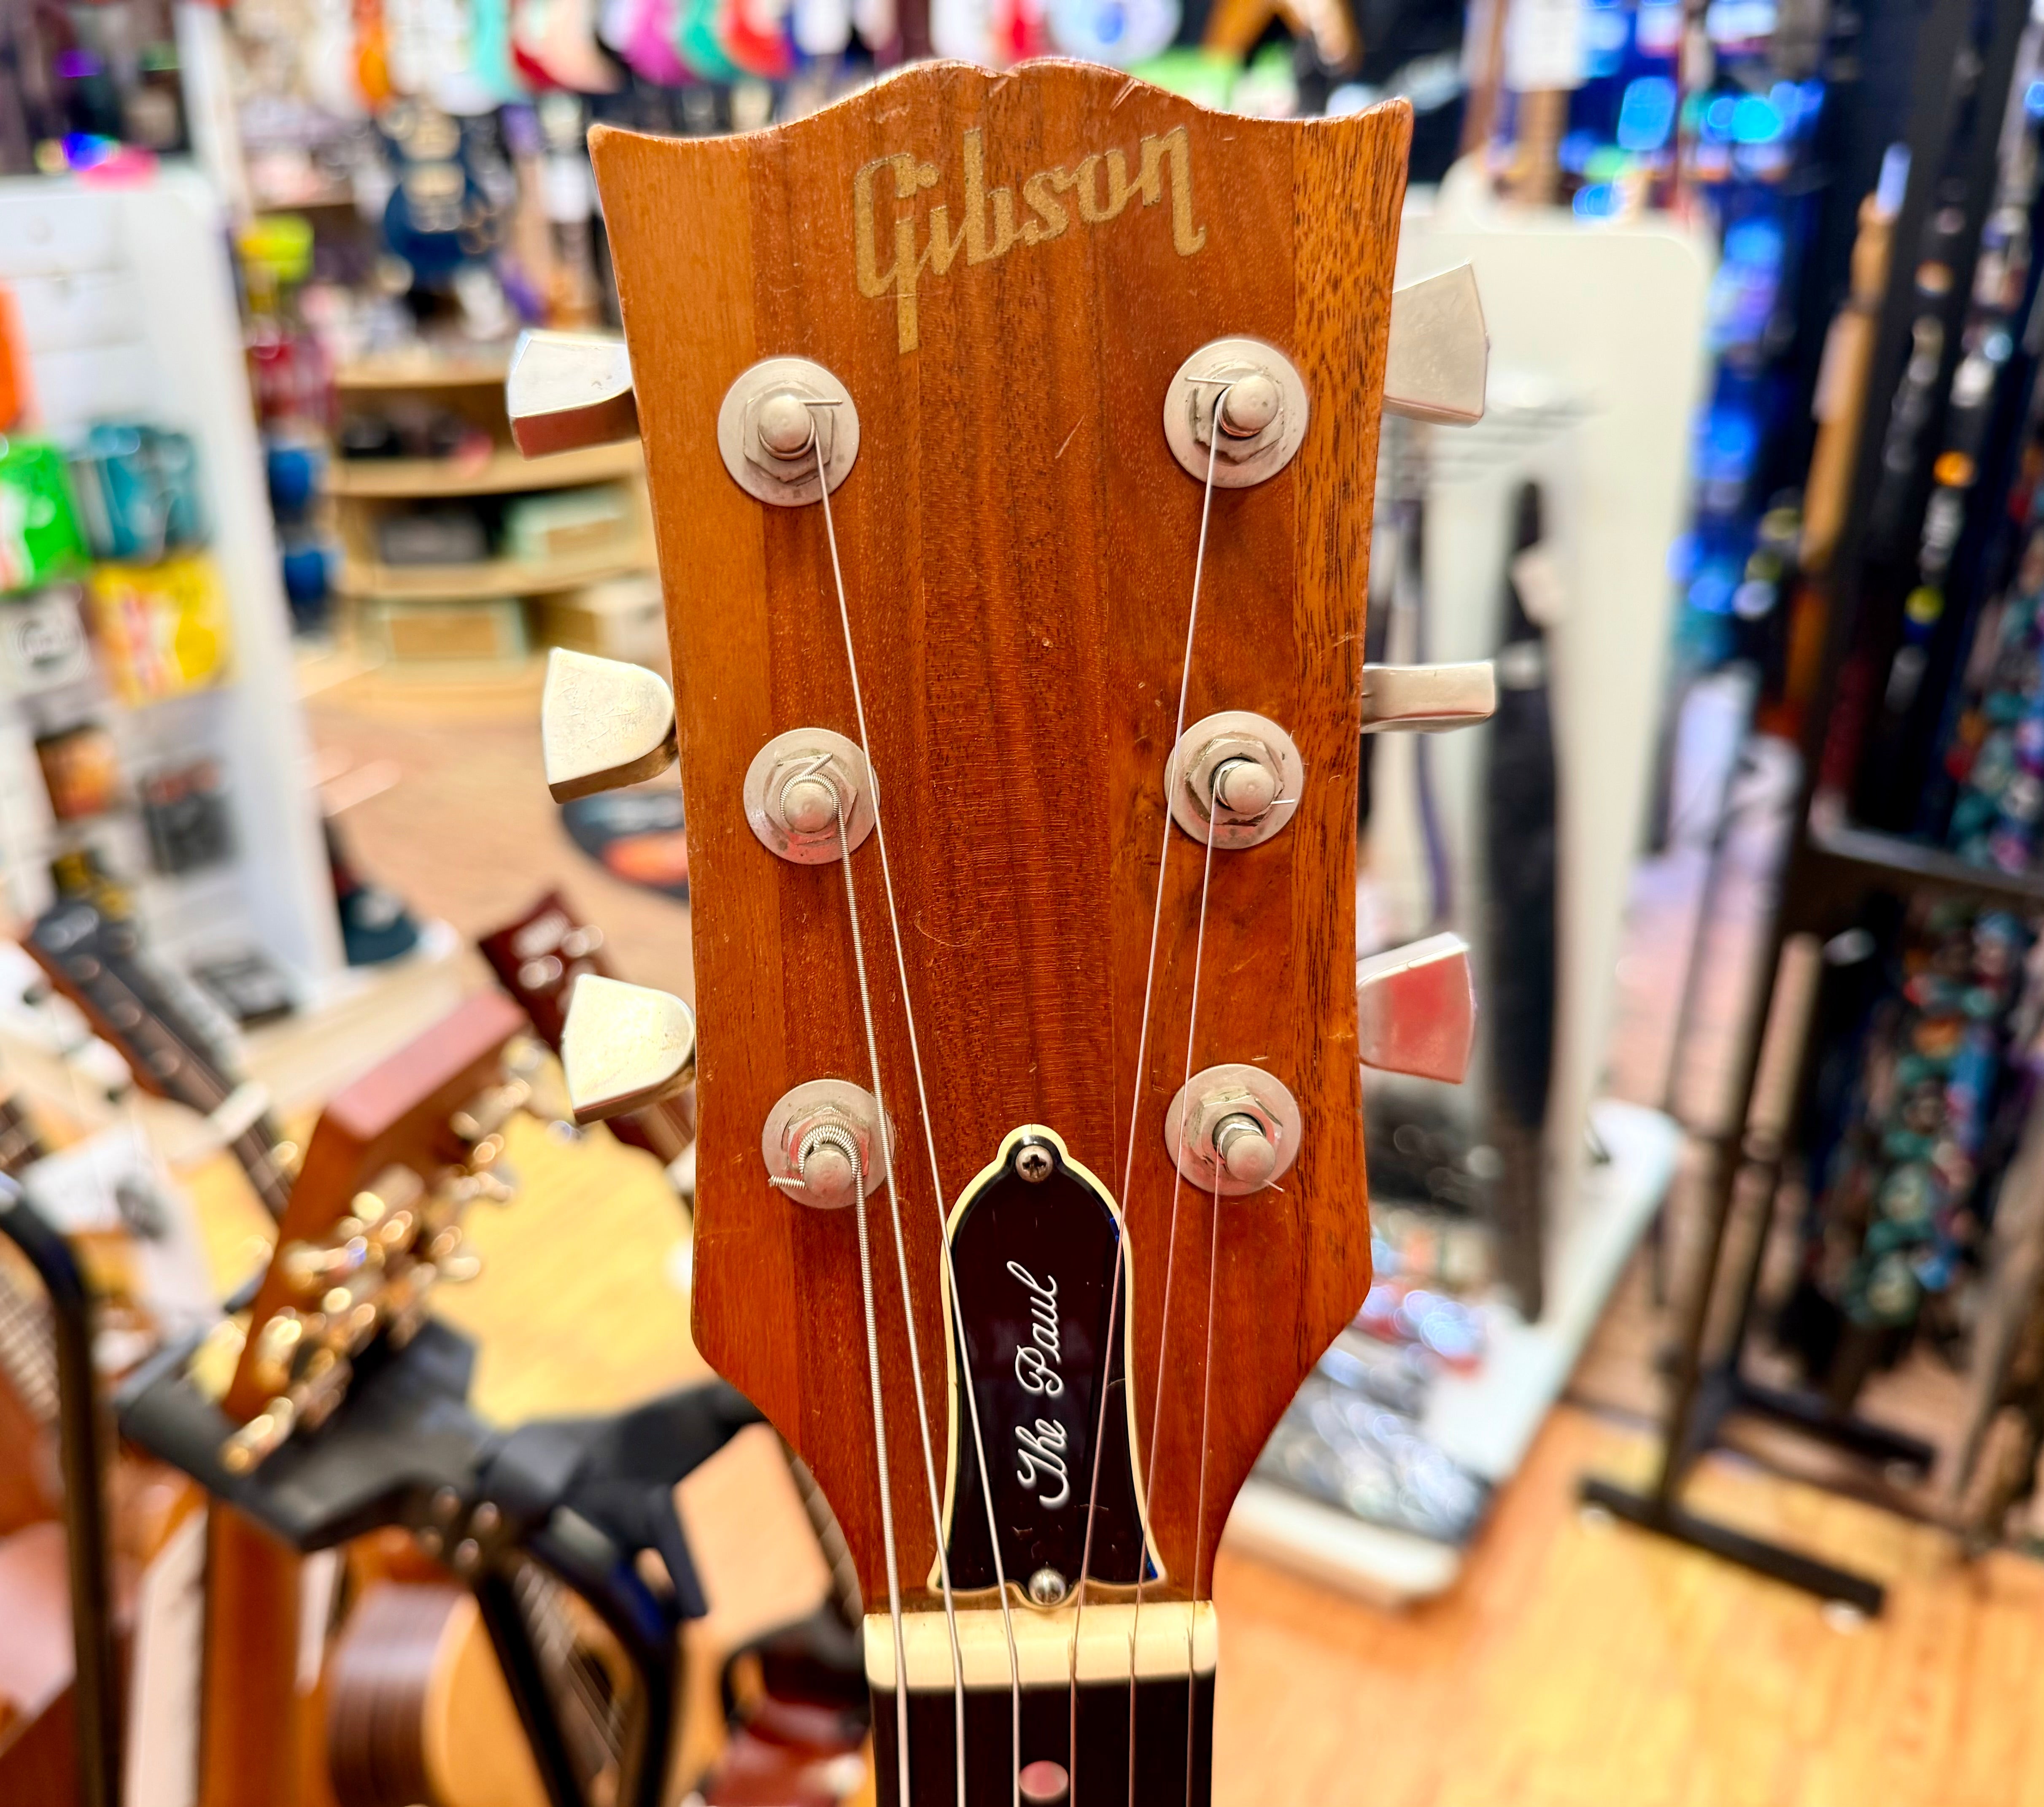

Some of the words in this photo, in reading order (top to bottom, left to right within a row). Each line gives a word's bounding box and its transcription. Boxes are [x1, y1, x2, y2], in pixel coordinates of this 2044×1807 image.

[854, 126, 1206, 354] Gibson
[1006, 1260, 1065, 1397] Paul
[1015, 1418, 1071, 1510] The
